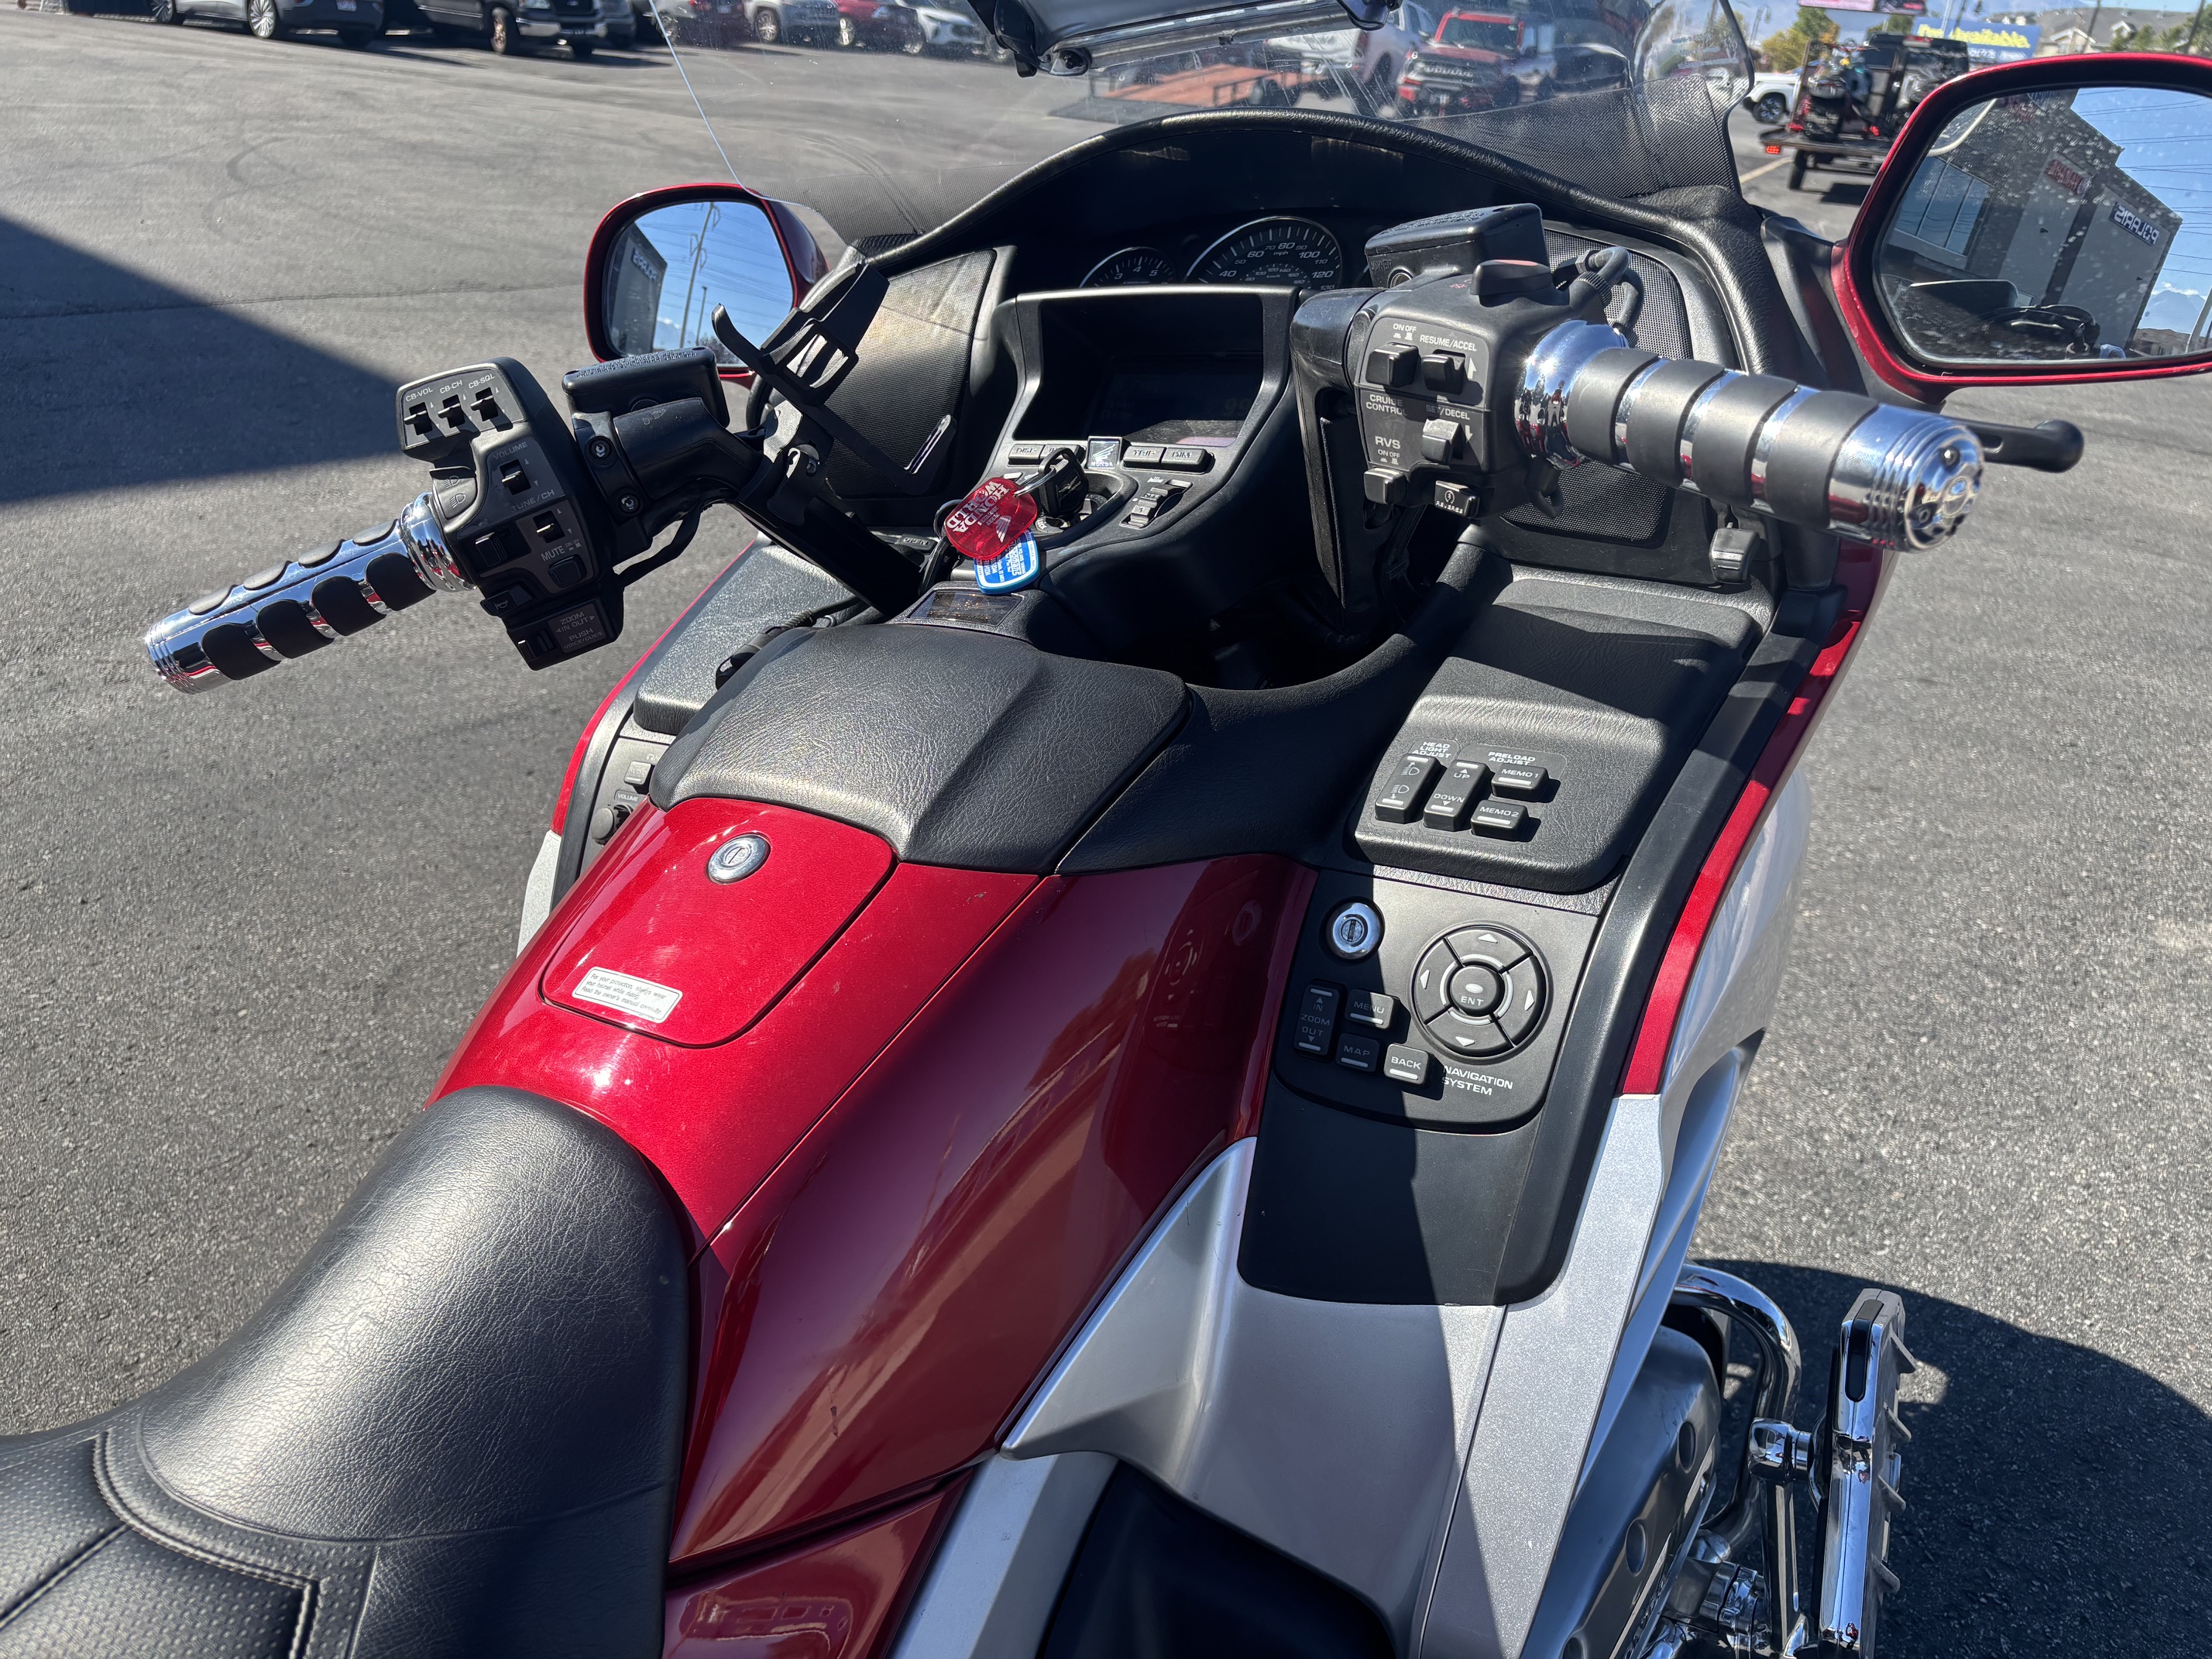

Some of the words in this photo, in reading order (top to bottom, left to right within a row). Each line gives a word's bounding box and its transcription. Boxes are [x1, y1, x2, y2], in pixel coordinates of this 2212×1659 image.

[1420, 335, 1477, 352] RESUME/ACCEL
[439, 380, 463, 394] CB-CH
[468, 373, 496, 389] CB-SQL
[405, 386, 434, 402] CB-VOL
[1369, 393, 1403, 407] CRUISE
[1365, 401, 1407, 416] CONTROL
[1426, 404, 1471, 421] SET/DECEL
[1375, 435, 1401, 449] RVS
[493, 441, 528, 460] VOLUME
[511, 489, 555, 511] TUNE/CH
[946, 481, 1001, 529] WORLD
[1435, 500, 1464, 514] REVERSE
[953, 485, 1009, 533] HONDA
[903, 537, 929, 546] OPEN
[541, 545, 566, 562] MUTE
[560, 611, 585, 625] ZOOM
[572, 617, 588, 627] OUT
[564, 631, 603, 649] VOICE/GUIDE
[568, 627, 593, 641] PUSH
[1411, 749, 1452, 758] ADJUST
[1488, 751, 1536, 762] PRELOAD
[1488, 757, 1531, 766] ADJUST
[1501, 768, 1534, 778] MEMO
[617, 793, 639, 802] VOLUME
[1433, 793, 1465, 803] DOWN
[1479, 806, 1512, 816] MEMO
[602, 992, 620, 1001] owner's
[621, 998, 640, 1008] manual
[653, 991, 666, 1000] wear
[1460, 995, 1484, 1006] ENT
[1354, 1001, 1385, 1014] MENU
[1300, 1013, 1331, 1026] ZOOM
[1301, 1026, 1324, 1037] OUT
[1343, 1046, 1370, 1056] MAP
[1390, 1056, 1422, 1070] BACK
[1443, 1065, 1513, 1090] NAVIGATION
[1441, 1077, 1492, 1096] SYSTEM
